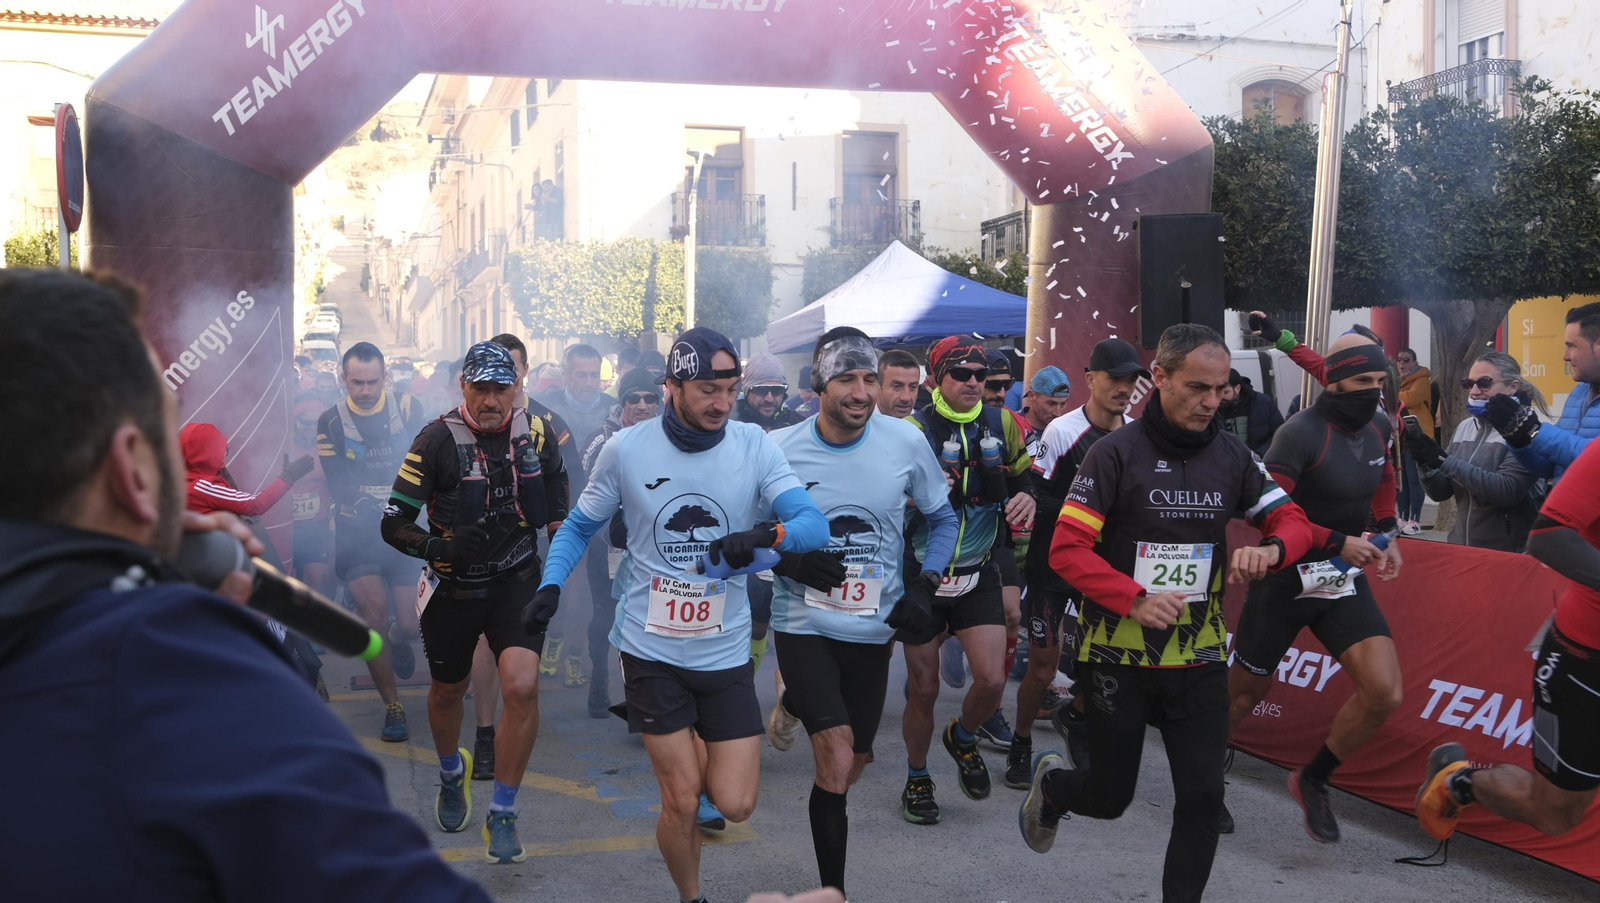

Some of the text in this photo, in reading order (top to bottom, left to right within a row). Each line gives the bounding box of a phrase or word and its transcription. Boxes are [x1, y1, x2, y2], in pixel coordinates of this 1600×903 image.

[212, 0, 366, 137] TEAMERGY
[995, 21, 1135, 162] TEAMERGY
[1522, 318, 1534, 335] Si
[1522, 361, 1546, 377] San
[1149, 489, 1224, 507] CUELLAR
[293, 502, 314, 514] 214
[663, 546, 673, 554] LA
[1161, 544, 1179, 552] CxM
[669, 555, 693, 563] LORCA
[1151, 563, 1198, 587] 245
[662, 578, 691, 590] IV CxM
[669, 588, 703, 598] PÓLVORA
[665, 599, 711, 623] 108
[1419, 678, 1534, 750] TEAM
